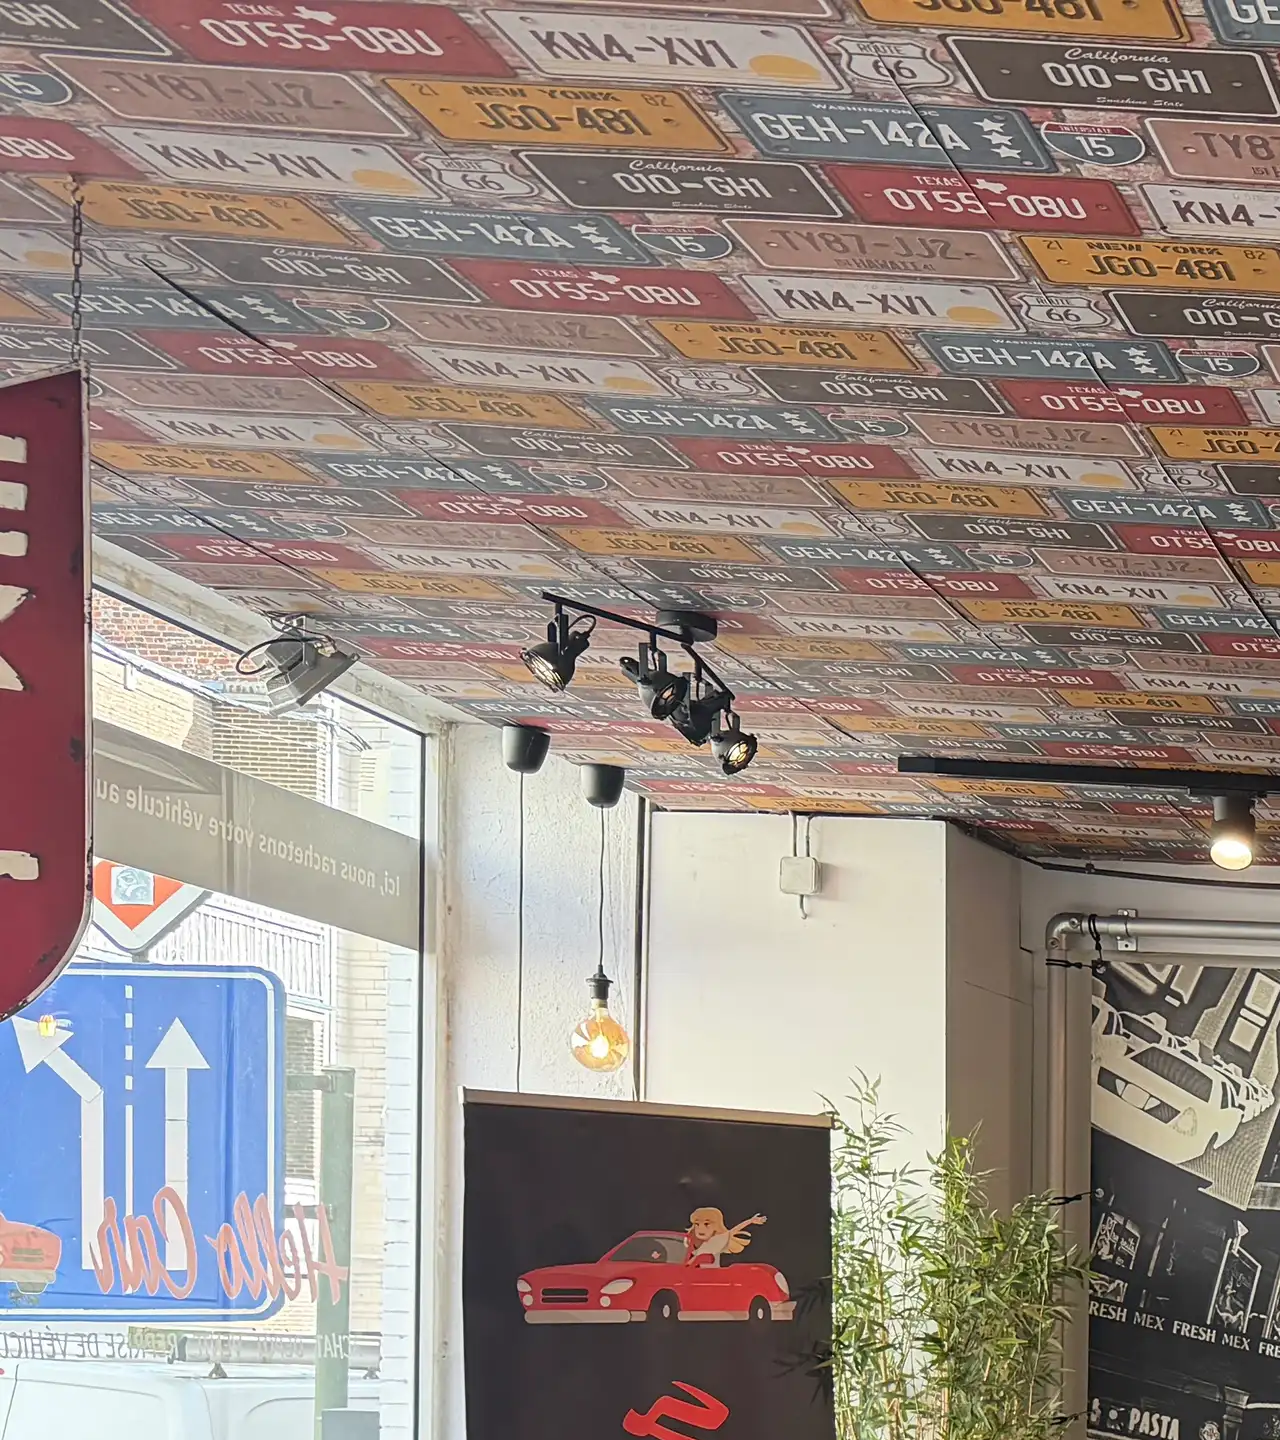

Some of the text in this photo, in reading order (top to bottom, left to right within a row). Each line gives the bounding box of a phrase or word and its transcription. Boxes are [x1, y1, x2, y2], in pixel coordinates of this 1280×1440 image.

[864, 56, 922, 80] 66
[756, 113, 971, 151] GEH-142A
[1074, 135, 1119, 158] 15
[1068, 498, 1219, 519] GEH-142A
[1088, 1300, 1127, 1324] RESH
[1132, 1311, 1164, 1332] MEX
[1172, 1320, 1217, 1344] FRESH
[1221, 1333, 1251, 1352] MEX
